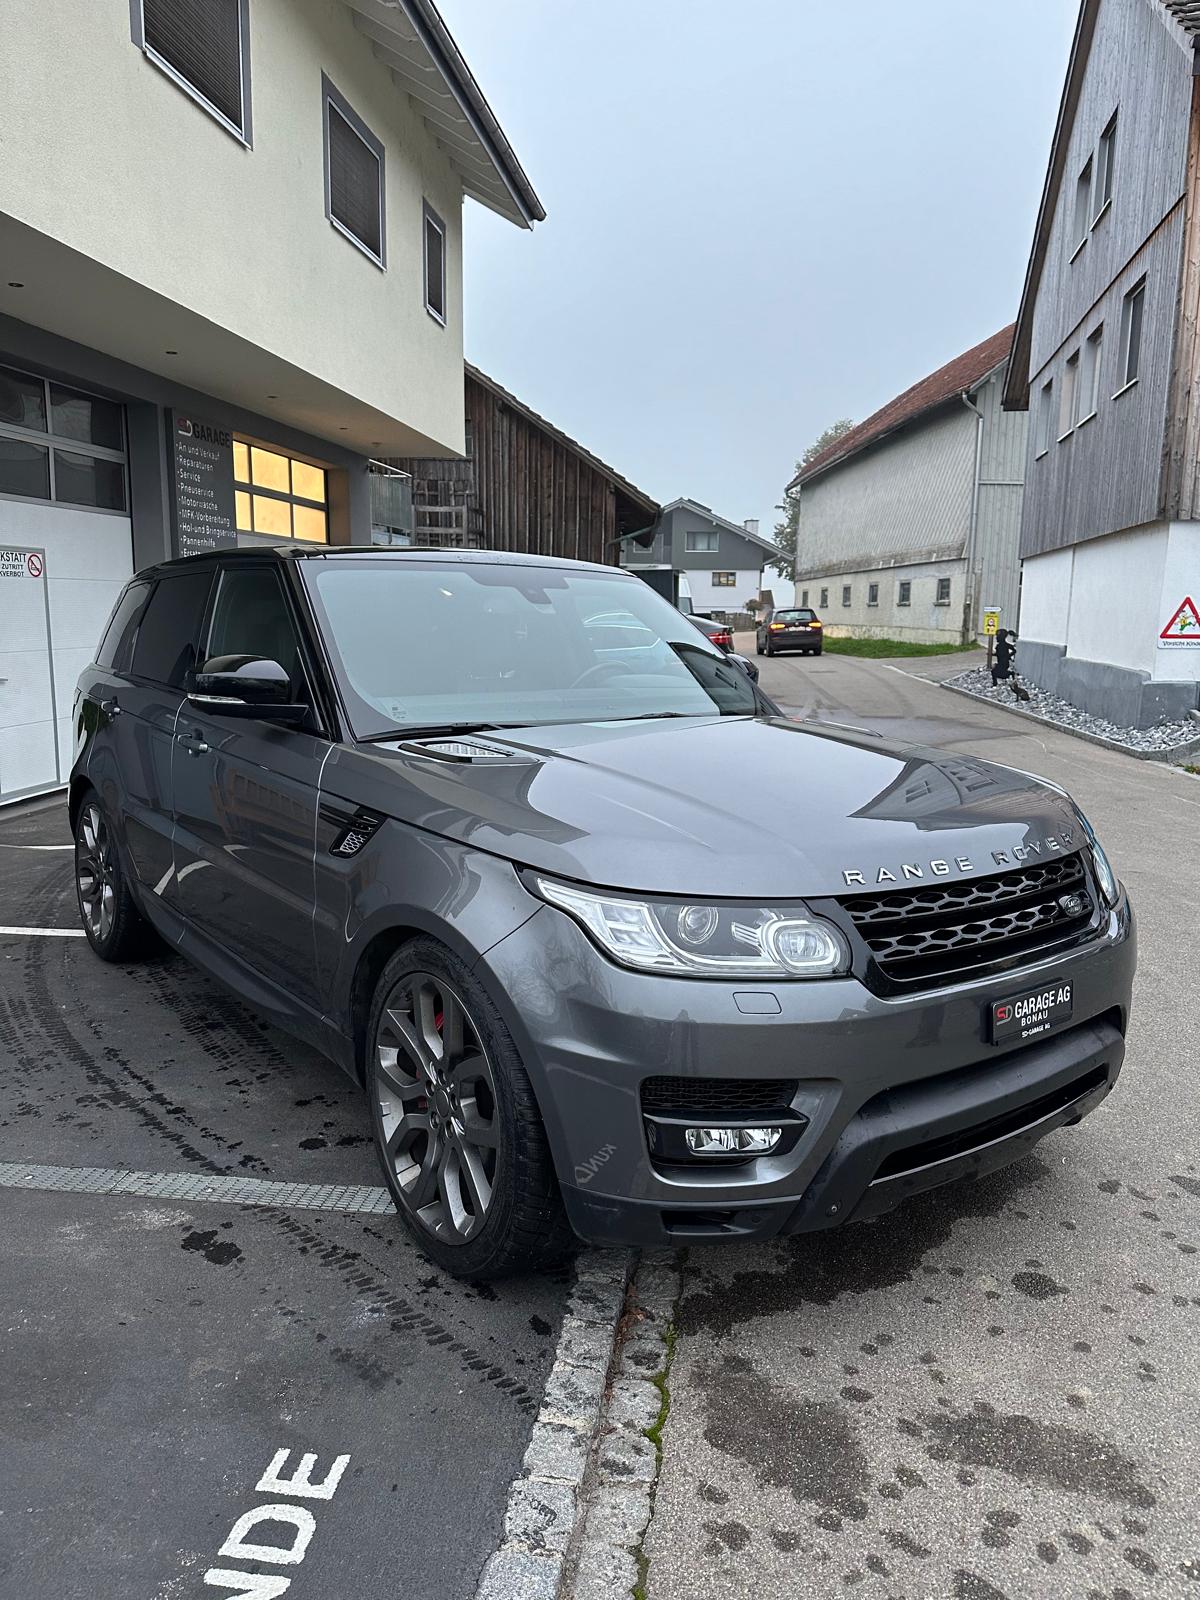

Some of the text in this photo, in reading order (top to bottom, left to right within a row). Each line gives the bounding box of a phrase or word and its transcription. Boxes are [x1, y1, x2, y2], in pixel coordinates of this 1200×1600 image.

[192, 423, 231, 448] GARAGE
[179, 455, 214, 472] Reparaturen
[180, 468, 201, 482] Service
[180, 482, 214, 498] Pneuservice
[206, 525, 237, 538] Bringservice
[182, 535, 216, 548] Pannenhilfe
[842, 832, 1075, 887] RANGE ROVER
[1014, 990, 1056, 1018] GARAGE
[1056, 985, 1071, 1005] AG
[1021, 1009, 1049, 1027] BONAU
